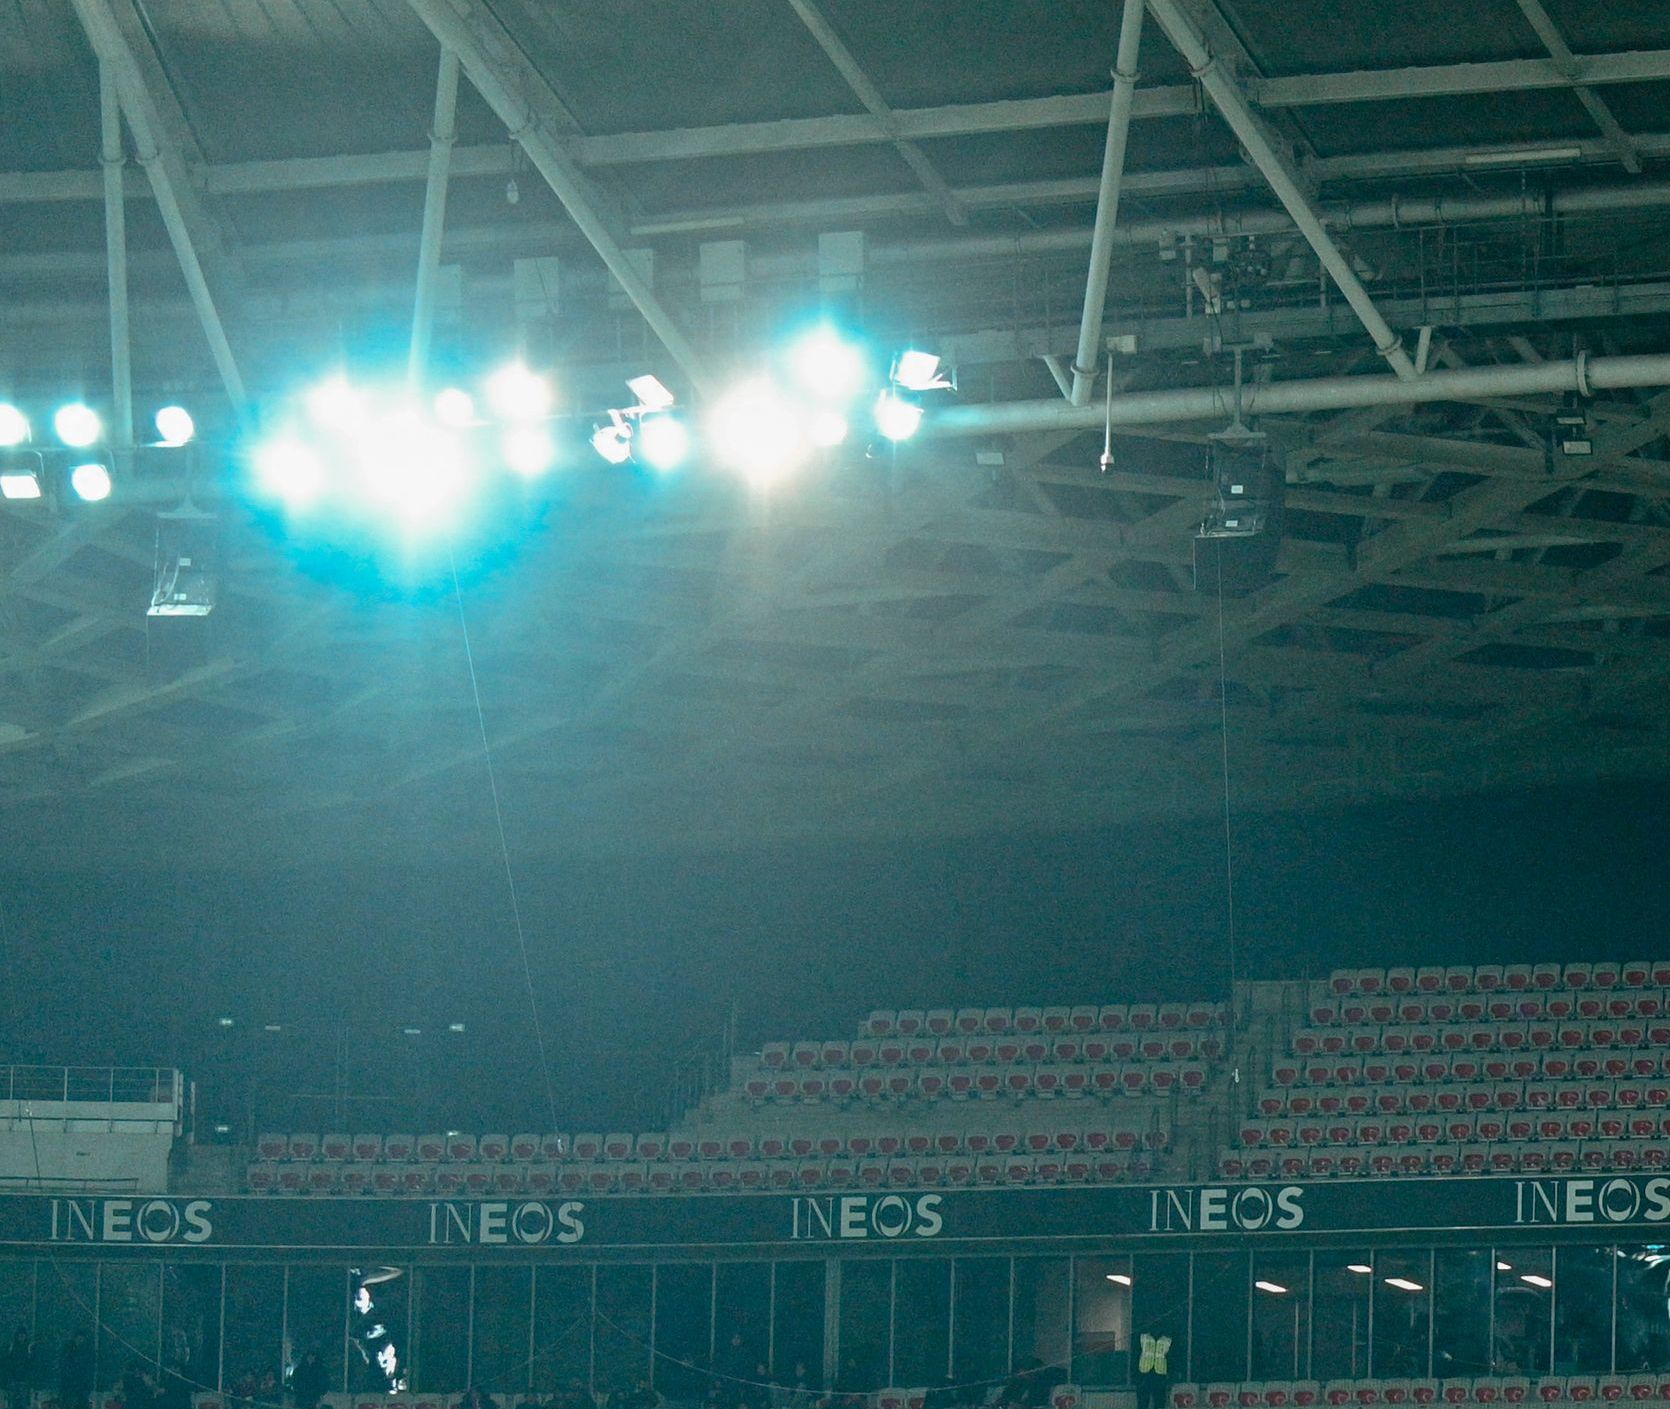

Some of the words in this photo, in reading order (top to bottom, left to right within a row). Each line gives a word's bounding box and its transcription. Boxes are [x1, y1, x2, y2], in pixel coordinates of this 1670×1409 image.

[50, 1199, 213, 1244] INEOS
[428, 1201, 586, 1244] INEOS
[790, 1194, 944, 1241] INEOS
[1149, 1186, 1304, 1232] INEOS
